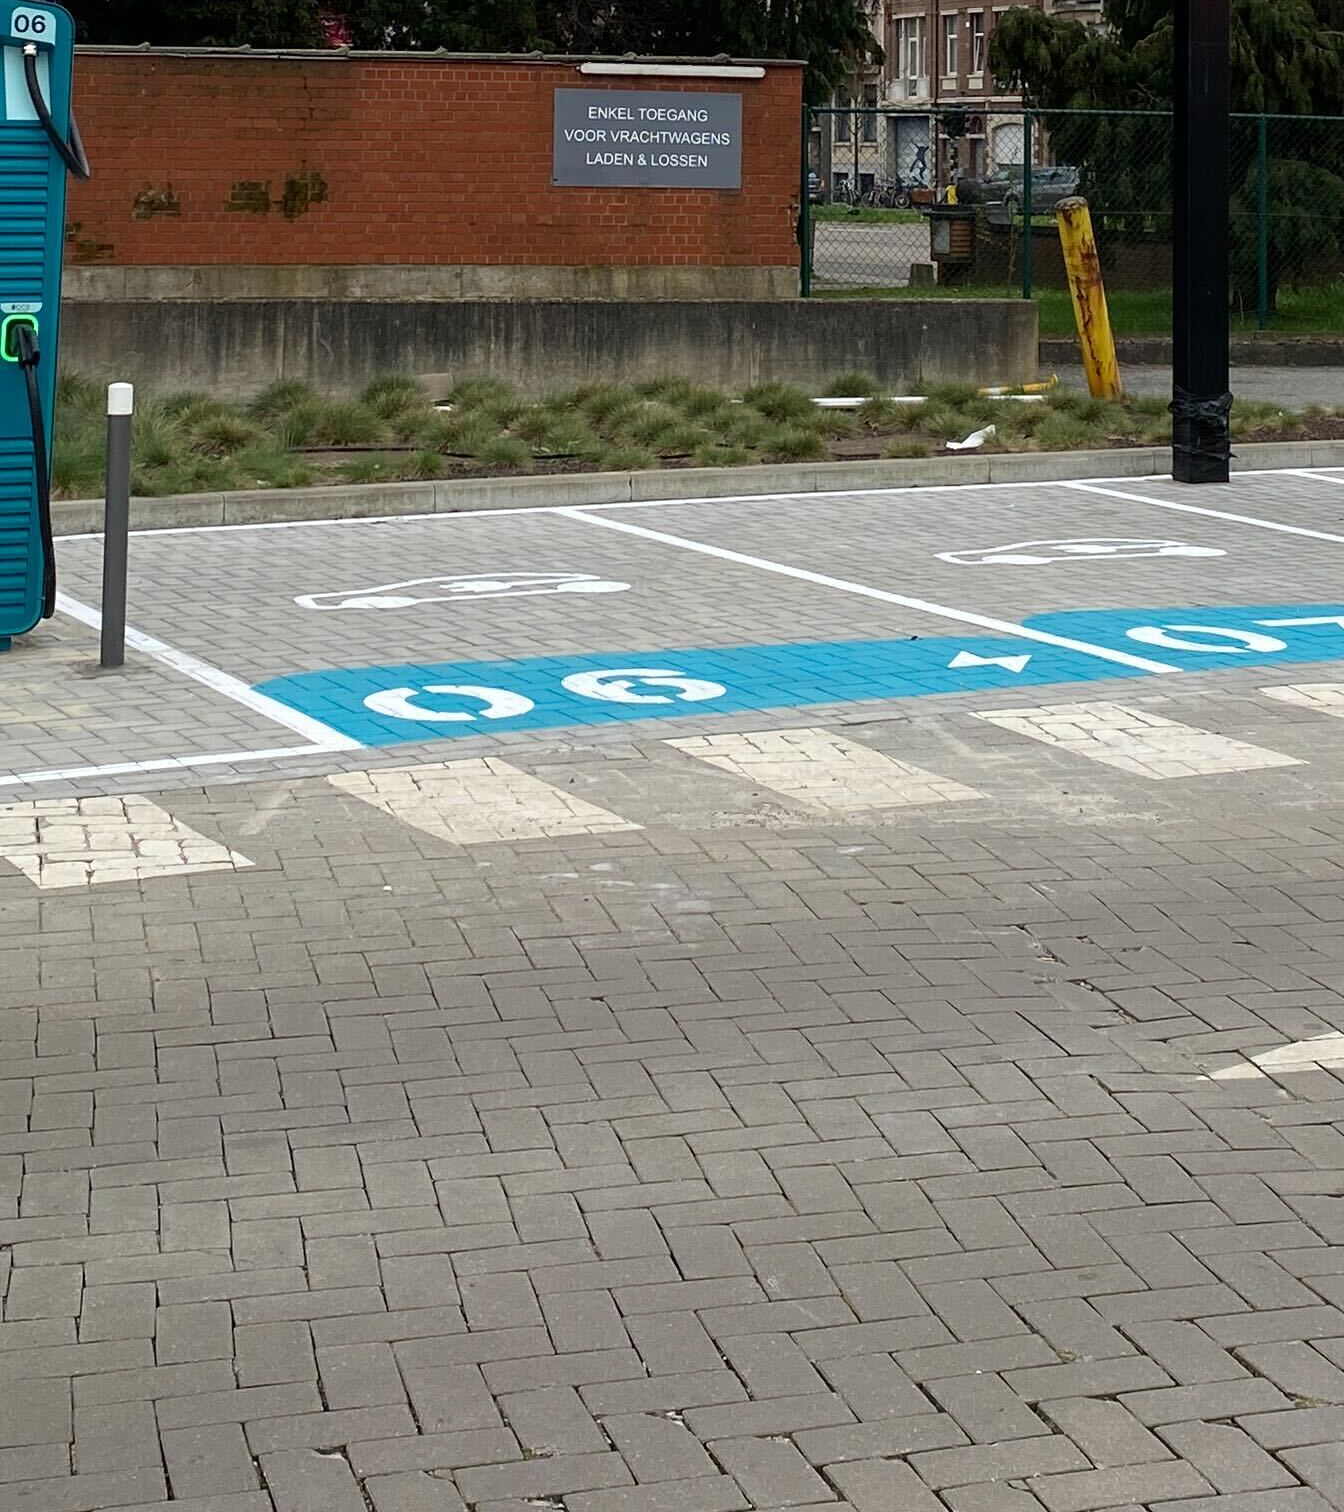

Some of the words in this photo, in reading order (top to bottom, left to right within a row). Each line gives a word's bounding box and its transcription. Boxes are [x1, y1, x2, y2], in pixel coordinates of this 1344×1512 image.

[14, 14, 46, 34] 06
[588, 106, 635, 120] ENKEL
[638, 107, 708, 122] TOEGANG
[563, 129, 607, 142] VOOR
[609, 131, 731, 146] VRACHTWAGENS
[586, 152, 634, 166] LADEN
[637, 153, 647, 166] &
[650, 154, 708, 168] LOSSEN
[363, 668, 727, 721] 06
